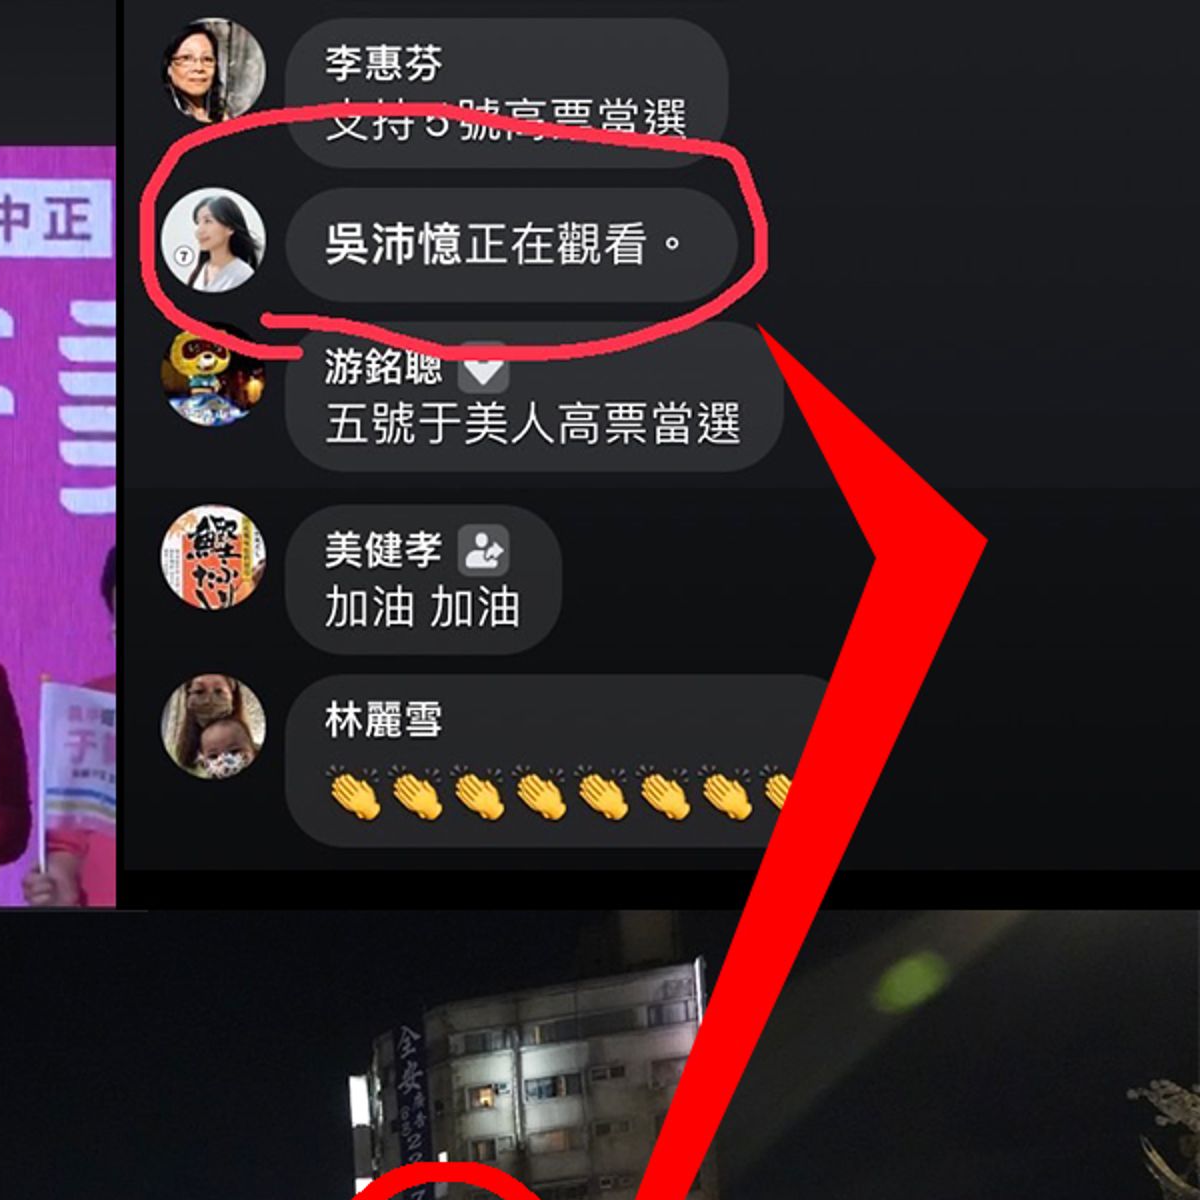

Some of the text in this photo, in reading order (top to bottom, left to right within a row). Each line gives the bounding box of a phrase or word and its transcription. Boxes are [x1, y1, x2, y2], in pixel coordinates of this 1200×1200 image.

[325, 44, 443, 82] 李惠芬
[325, 401, 741, 446] 五號于美人高票當選
[325, 530, 442, 570] 美健孝
[325, 585, 521, 629] 加油 加油
[325, 700, 443, 739] 林麗雪
